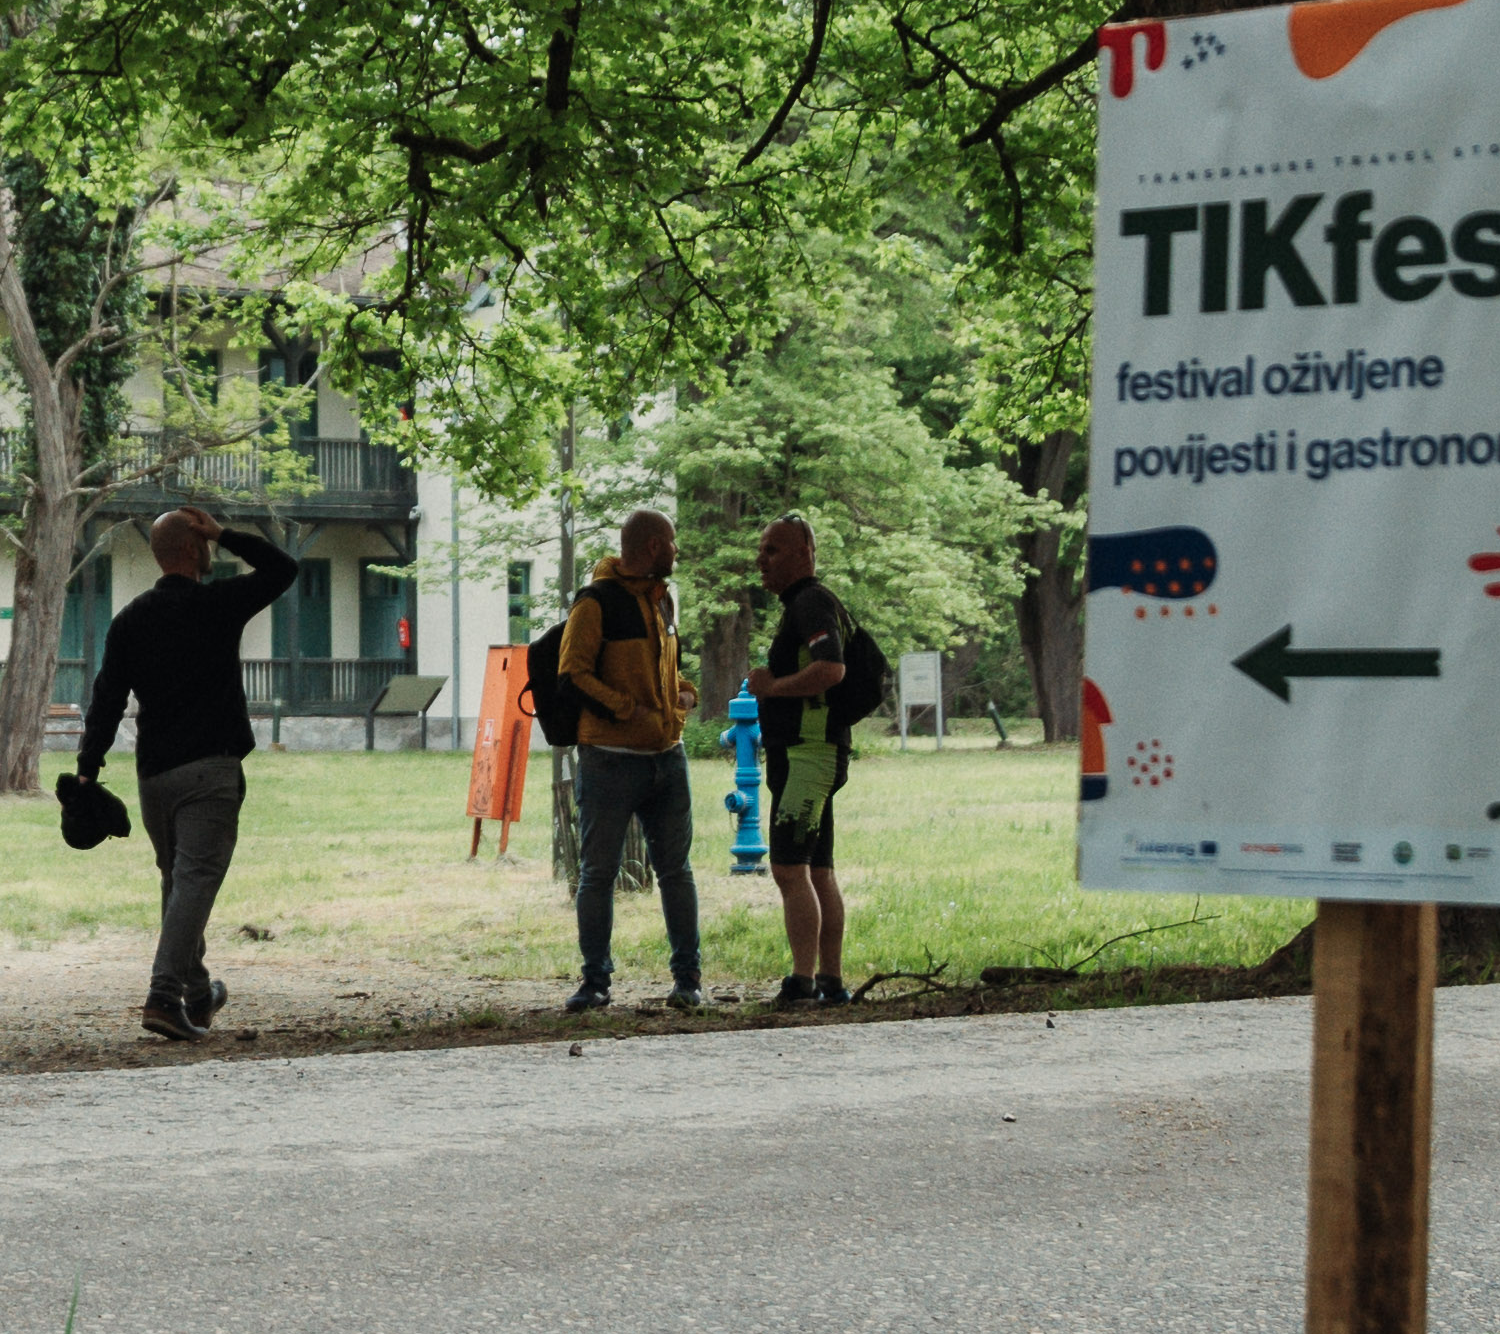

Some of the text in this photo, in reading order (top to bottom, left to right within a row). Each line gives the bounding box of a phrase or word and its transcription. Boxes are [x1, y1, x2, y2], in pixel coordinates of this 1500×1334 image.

[1333, 148, 1433, 169] TRAVEL
[1115, 349, 1446, 404] festival oživljene
[1113, 430, 1278, 488] povijesti
[1286, 429, 1298, 474] i
